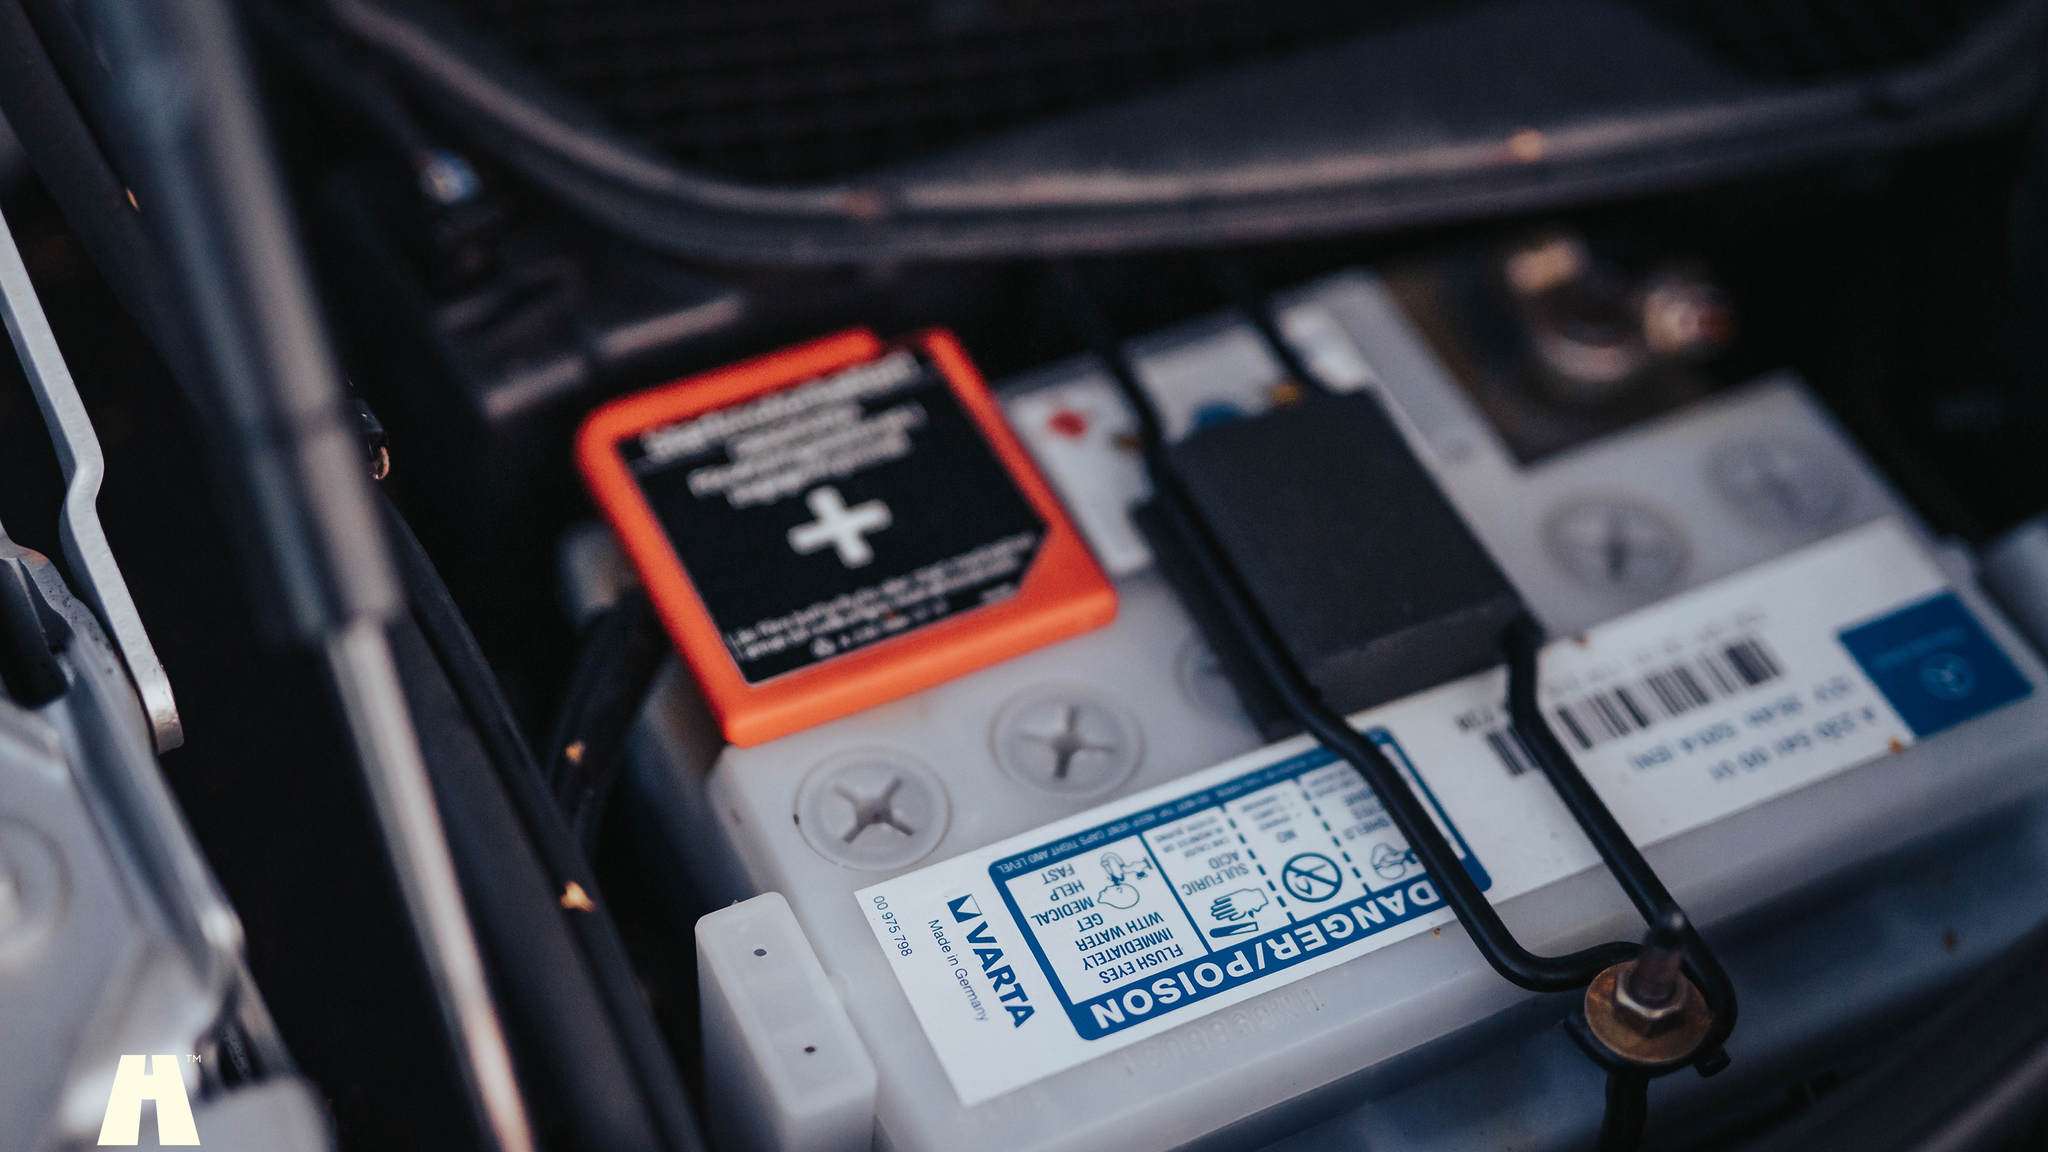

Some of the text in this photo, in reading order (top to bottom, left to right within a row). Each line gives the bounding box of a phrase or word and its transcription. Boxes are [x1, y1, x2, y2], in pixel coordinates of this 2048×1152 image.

[1078, 830, 1105, 846] CAPS
[1106, 821, 1131, 837] VENT
[1274, 828, 1297, 844] NO
[1027, 849, 1049, 864] AND
[1050, 839, 1078, 856] TIGHT
[996, 857, 1027, 873] LEVEL
[1207, 850, 1240, 870] ACID
[1041, 863, 1075, 884] FAST
[1180, 862, 1249, 895] SULFURIC
[1049, 879, 1085, 901] HELP
[1030, 896, 1095, 926] MEDICAL
[1076, 912, 1104, 932] GET
[873, 895, 912, 957] 00 975 798
[1074, 911, 1164, 951] WITH WATER
[1082, 927, 1174, 970] IMMEDIATELY
[1089, 879, 1438, 1029] DANGER/POISON
[927, 919, 988, 1022] Made in Germany
[1098, 943, 1184, 983] FLUSH EYES
[965, 921, 1036, 1028] VARTA
